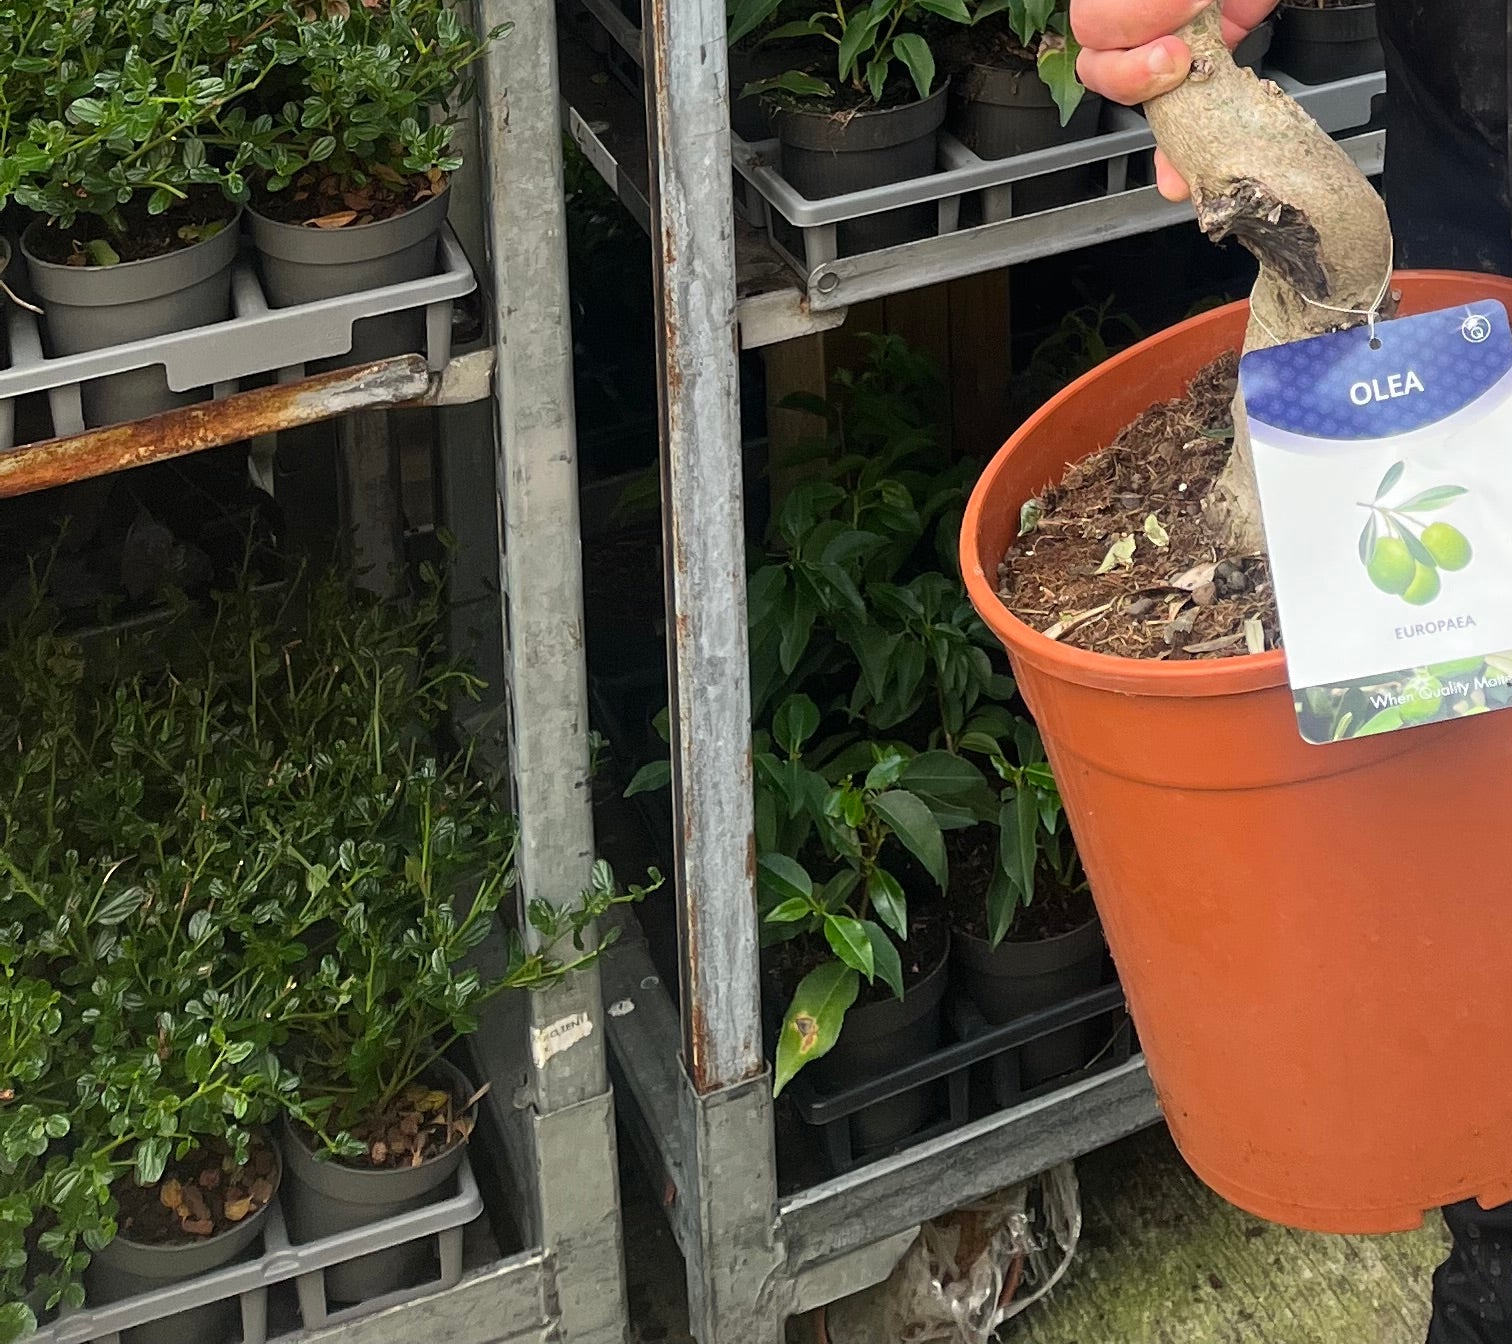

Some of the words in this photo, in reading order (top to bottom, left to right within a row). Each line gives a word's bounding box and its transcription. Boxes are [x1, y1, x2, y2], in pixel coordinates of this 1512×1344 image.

[1349, 370, 1425, 407] OLEA
[1394, 615, 1477, 640] EUROPAEA
[1370, 692, 1415, 710] When
[1418, 679, 1470, 700] Quality
